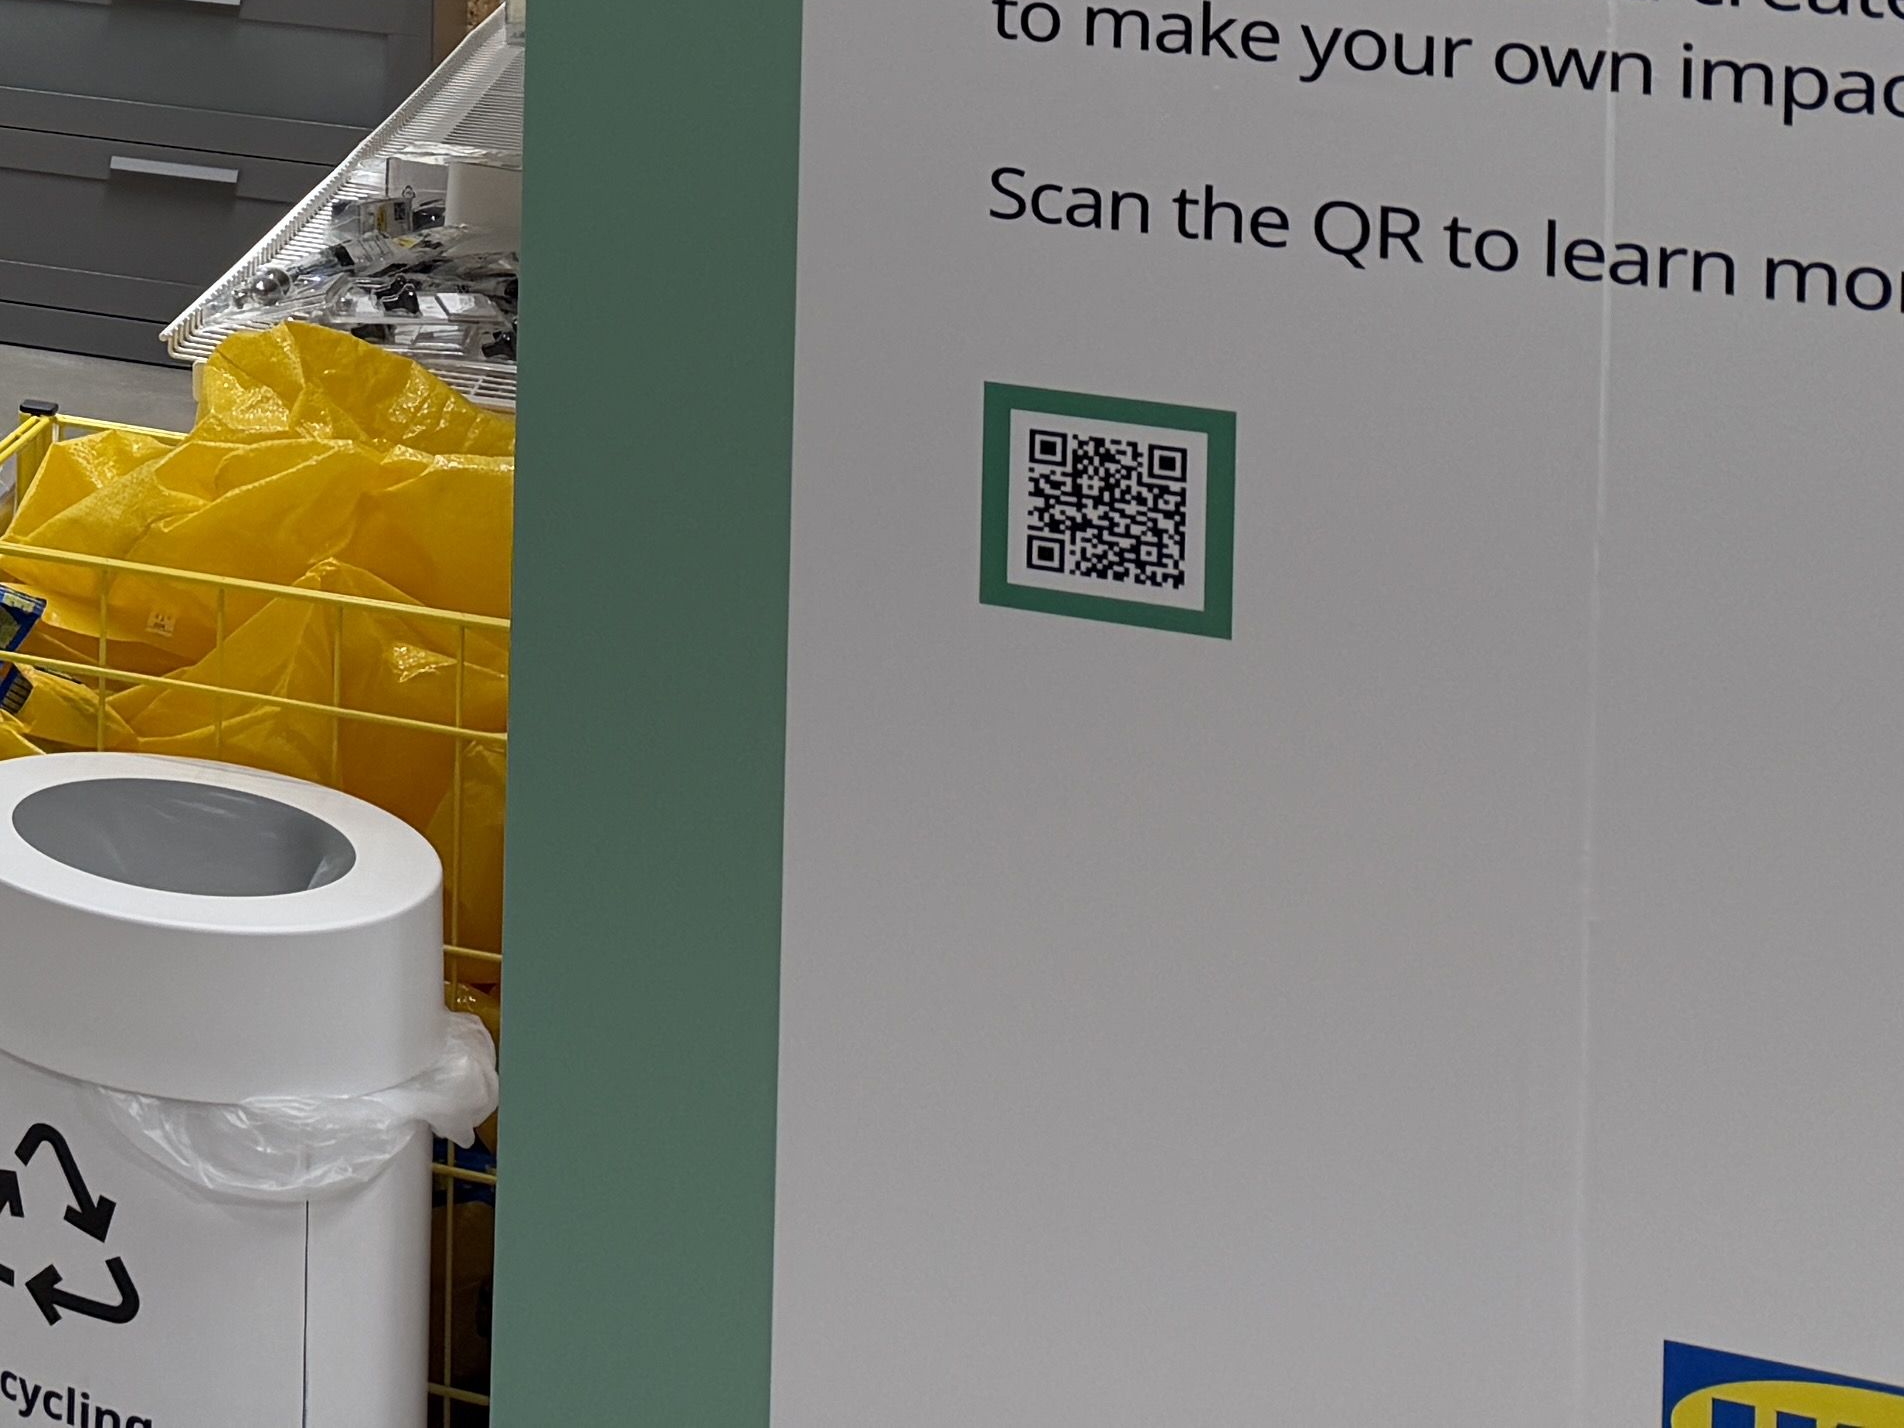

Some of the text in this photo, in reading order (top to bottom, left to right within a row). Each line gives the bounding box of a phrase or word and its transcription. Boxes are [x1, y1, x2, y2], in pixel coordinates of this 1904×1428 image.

[1086, 0, 1280, 63] make
[1299, 24, 1473, 83] your
[1494, 42, 1652, 95] own
[989, 167, 1904, 314] Scan the QR to learn mo
